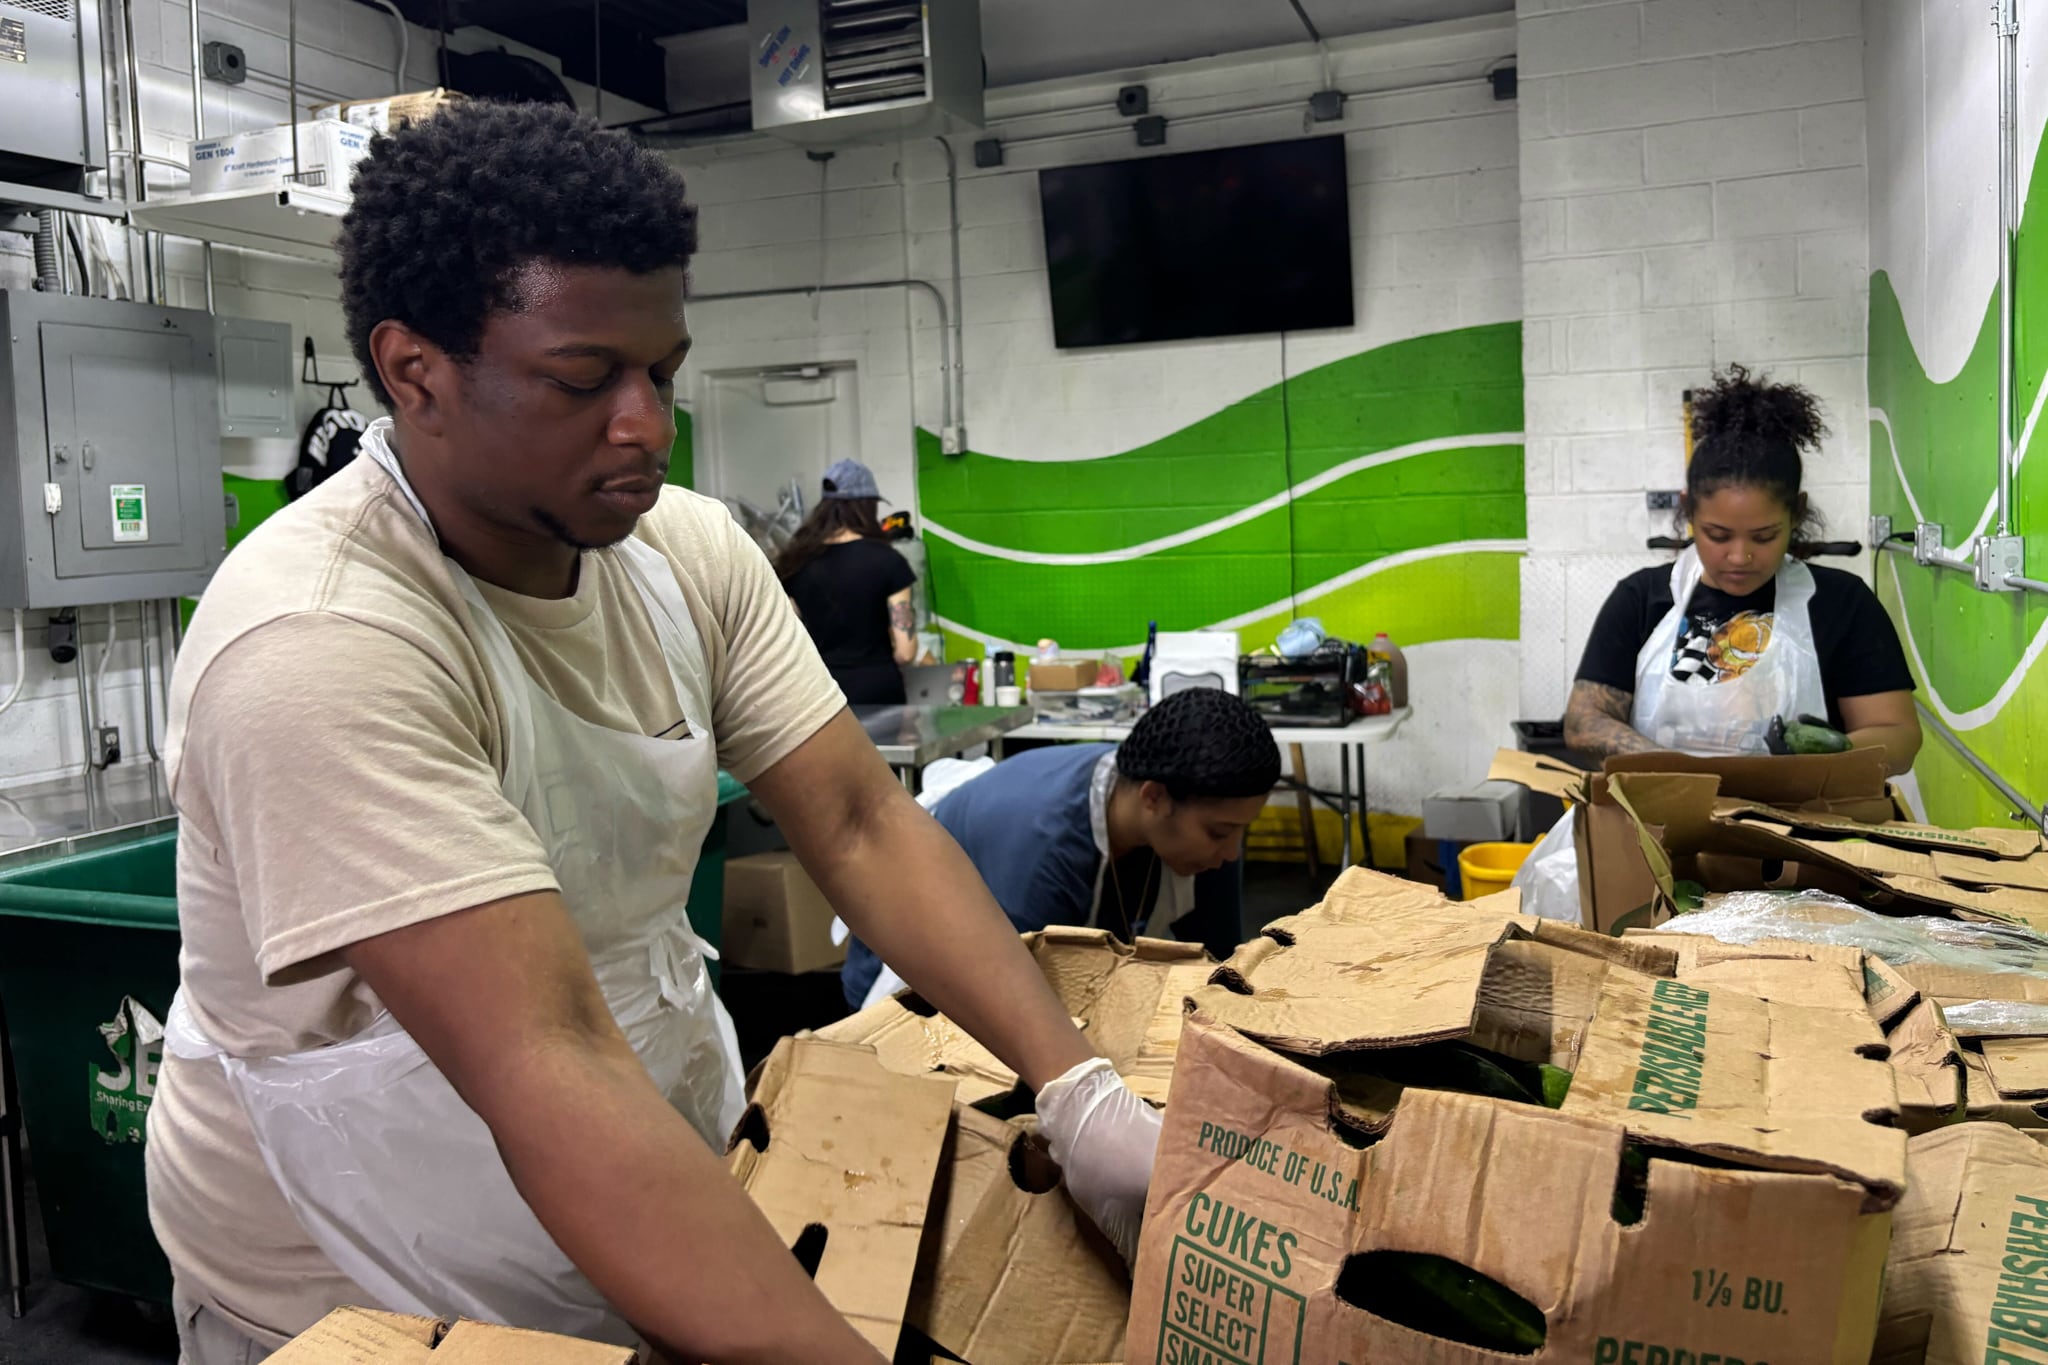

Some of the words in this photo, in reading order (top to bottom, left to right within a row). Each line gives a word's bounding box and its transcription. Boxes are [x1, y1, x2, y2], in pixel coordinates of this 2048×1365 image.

[195, 148, 214, 161] GEN
[215, 146, 235, 158] 1804
[96, 1091, 135, 1112] Sharing
[1198, 1121, 1283, 1176] PRODUCE
[1283, 1151, 1310, 1186] OF
[1310, 1162, 1361, 1213] U.S.A.
[1185, 1192, 1298, 1279] CUKES
[1181, 1253, 1255, 1316] SUPER
[1743, 1277, 1789, 1316] BU.
[1165, 1333, 1232, 1365] SMA
[1174, 1291, 1257, 1357] SELECT
